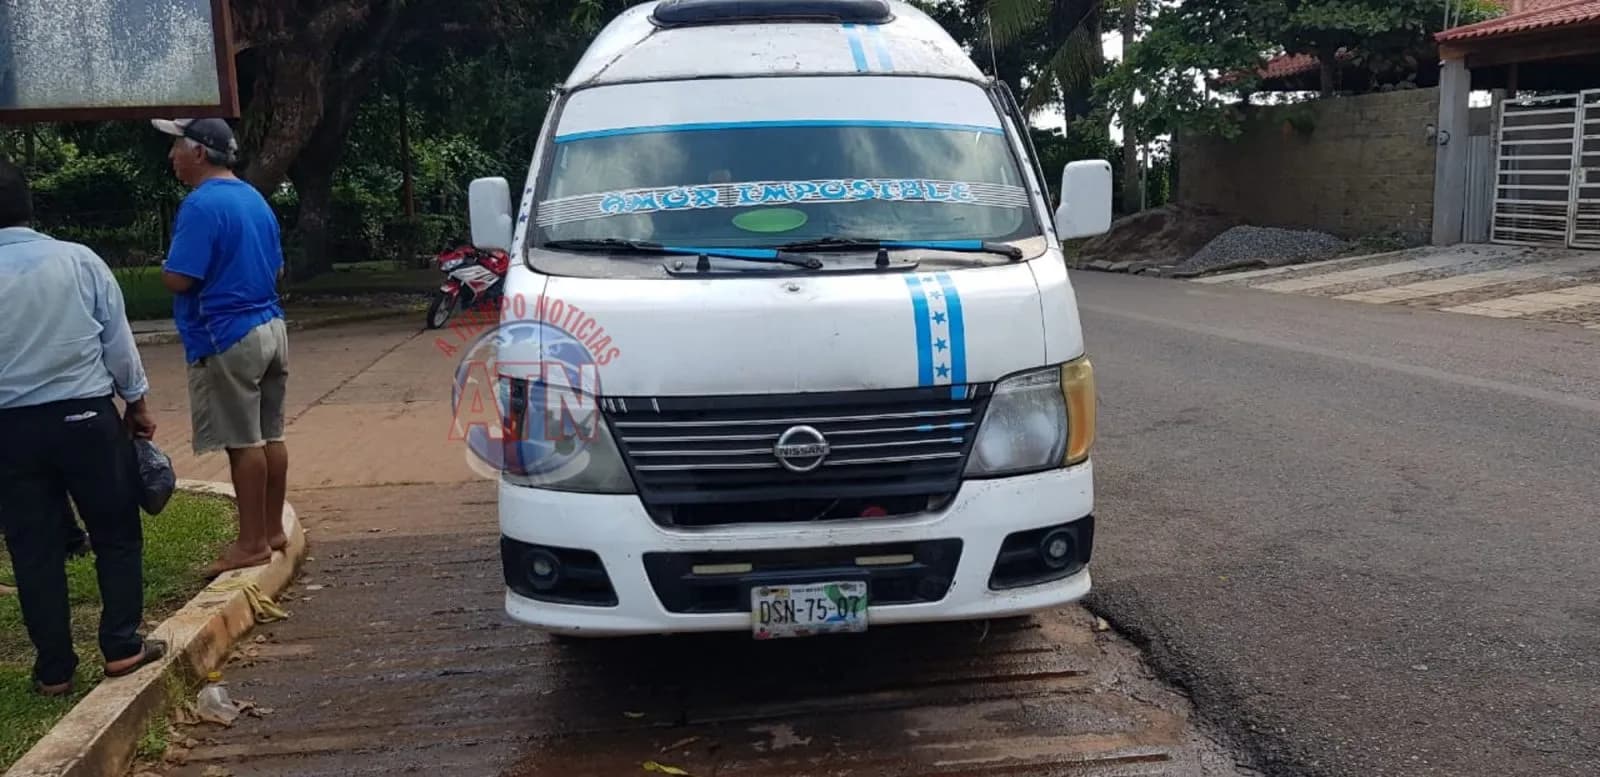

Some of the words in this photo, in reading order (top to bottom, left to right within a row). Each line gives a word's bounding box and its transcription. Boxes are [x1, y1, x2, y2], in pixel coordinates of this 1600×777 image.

[600, 186, 719, 213] AMOR
[737, 181, 973, 207] IMPOSIBLE
[779, 446, 825, 456] NISSAN
[760, 595, 861, 624] DSN-75-07
